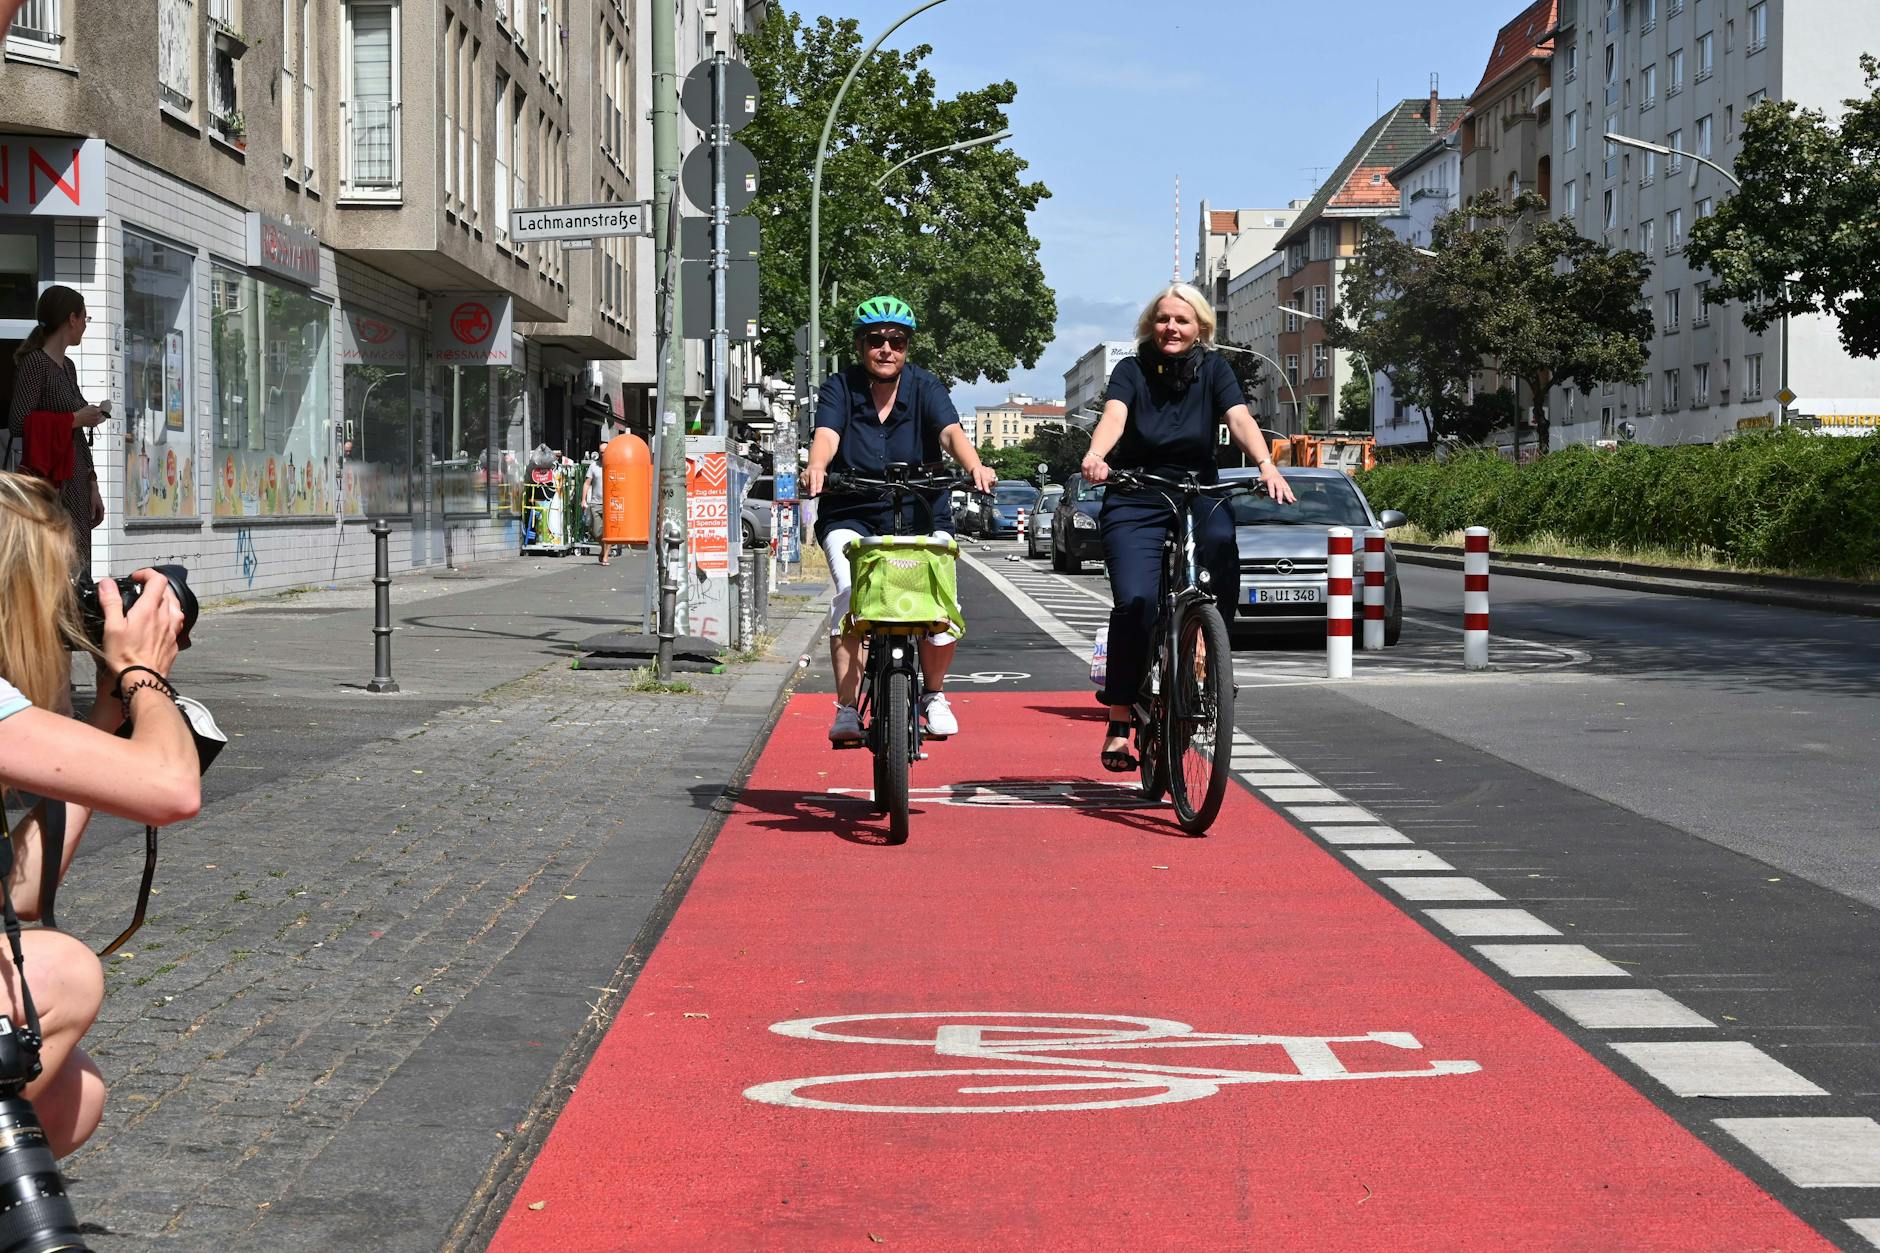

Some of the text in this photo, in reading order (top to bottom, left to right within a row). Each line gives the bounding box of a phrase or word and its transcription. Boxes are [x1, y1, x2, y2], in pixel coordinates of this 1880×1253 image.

[0, 144, 80, 206] N
[519, 211, 637, 231] Lachmannstraße
[437, 350, 507, 360] ROSSMANN
[696, 504, 727, 517] 202
[1260, 590, 1315, 601] B UI 348
